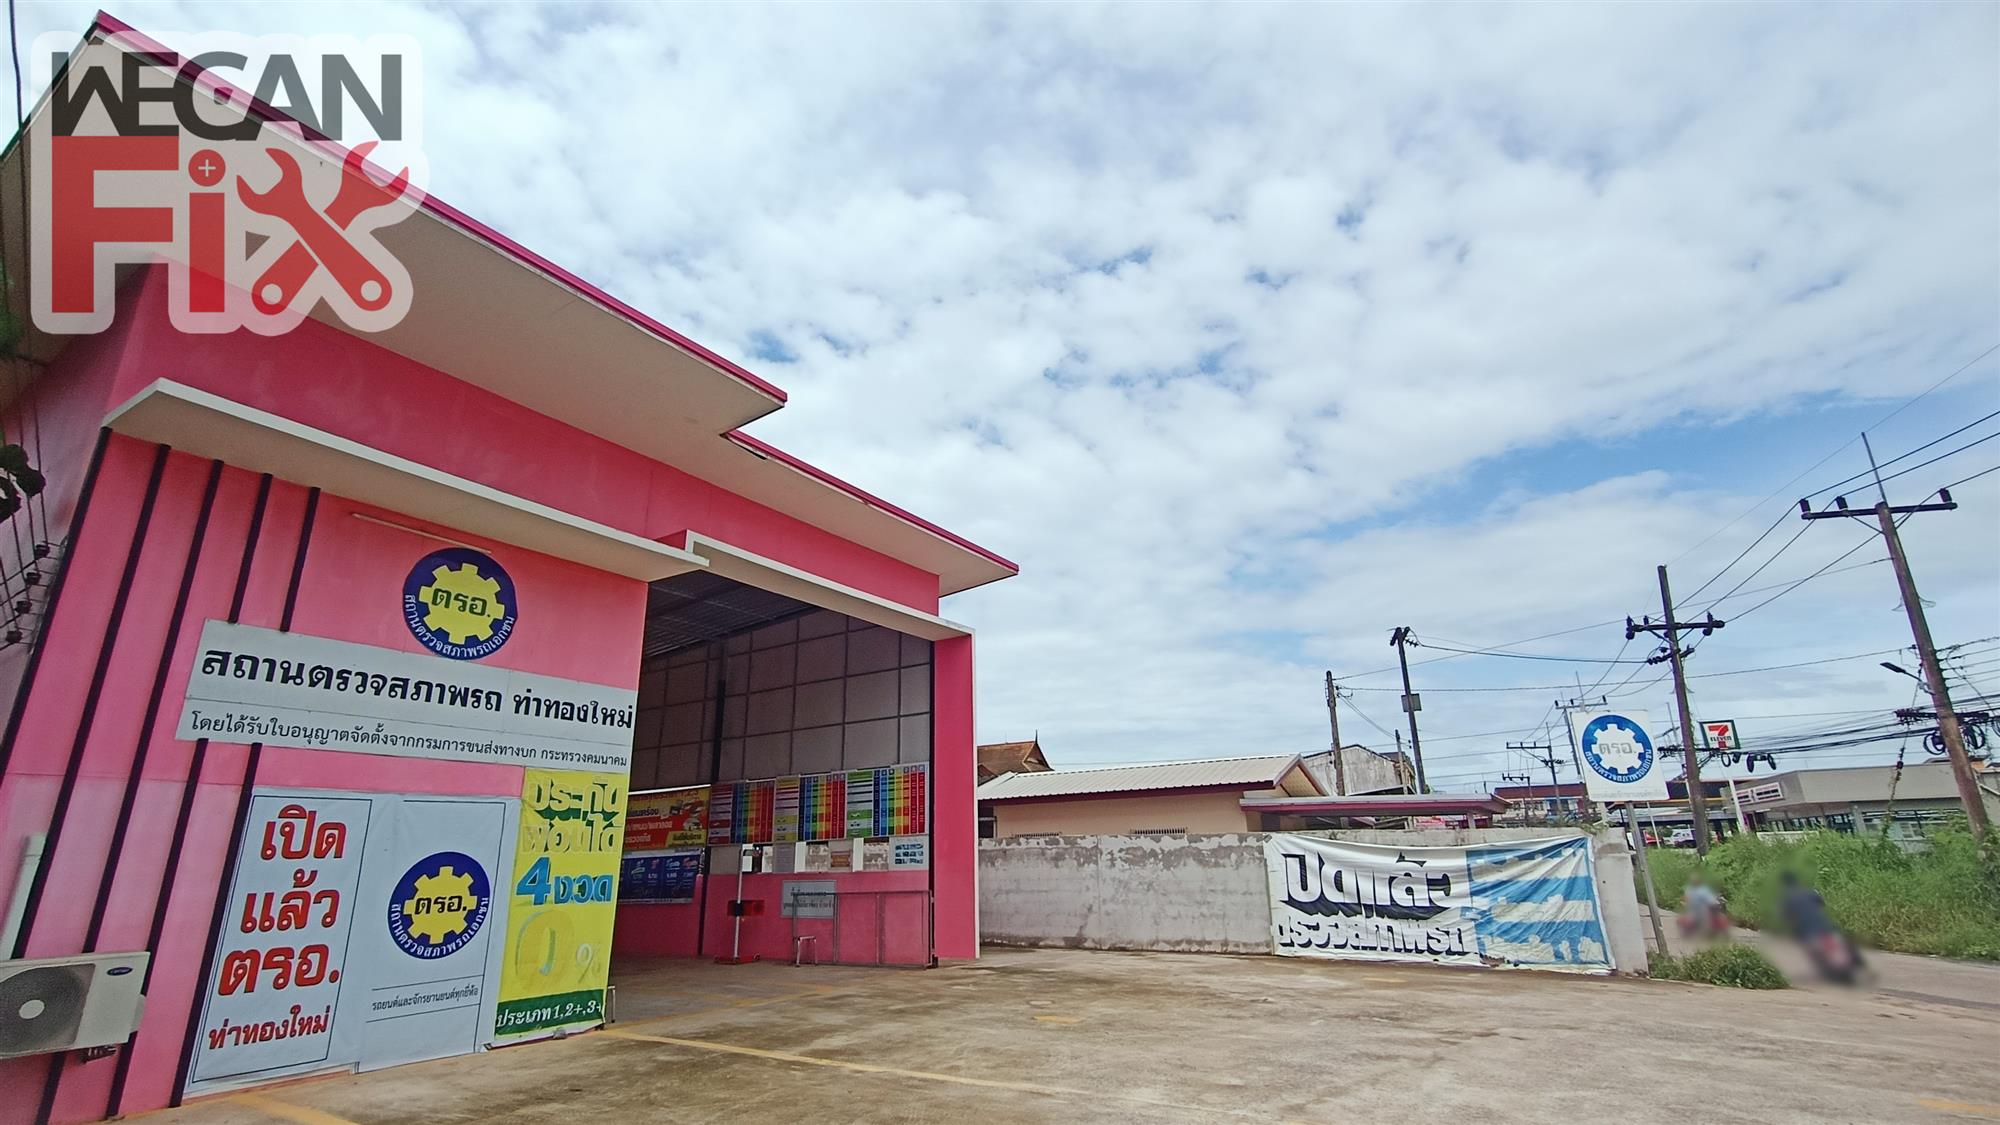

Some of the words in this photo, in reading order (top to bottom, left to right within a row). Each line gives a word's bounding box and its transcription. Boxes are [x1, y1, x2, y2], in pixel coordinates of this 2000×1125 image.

[405, 594, 515, 658] สถานตรวจสภาพรถเอกชน
[431, 588, 491, 618] ตรอ.
[201, 650, 503, 712] สถานตรวจสภาพรถ
[513, 688, 633, 729] ท่าทองใหม่
[191, 711, 537, 759] โดยได้รับใบอนุญาตจัดตั้งจากกรมการขนส่งทางบก
[541, 748, 628, 767] กระทรวงคมนาคม
[260, 803, 348, 861] เปิด
[240, 868, 341, 934] แล้ว
[414, 895, 468, 915] ตรอ.
[516, 856, 552, 906] 4
[553, 874, 614, 905] งวด
[391, 897, 489, 957] สถานตรวจสภาพรถเอกชน
[217, 943, 340, 997] ตรอ.
[208, 1005, 330, 1051] ท่าทองใหม่
